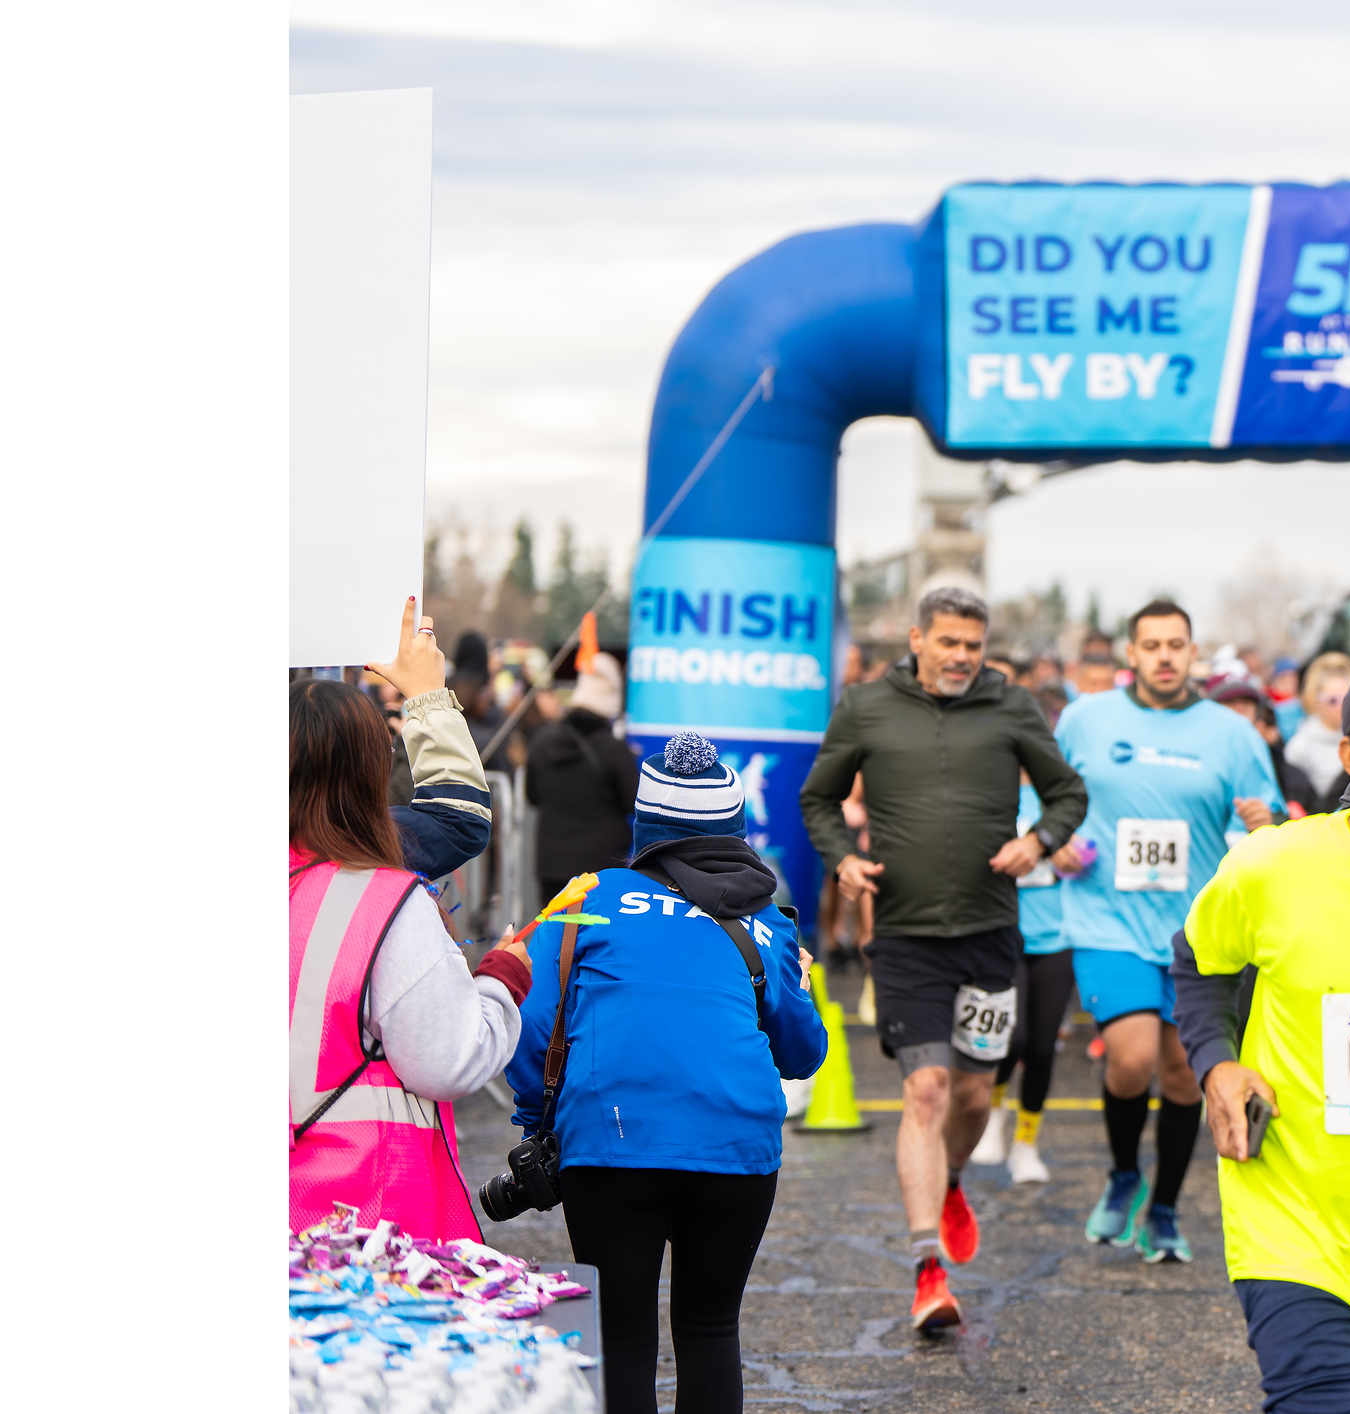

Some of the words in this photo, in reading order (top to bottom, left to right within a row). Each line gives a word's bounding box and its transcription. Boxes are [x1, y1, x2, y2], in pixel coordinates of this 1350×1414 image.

[969, 236, 1073, 273] DID
[1094, 235, 1213, 273] YOU
[972, 296, 1075, 335] SEE
[1098, 297, 1180, 335] ME
[967, 354, 1074, 399] FLY
[1086, 354, 1195, 399] BY?
[637, 587, 817, 642] FINISH
[1129, 840, 1177, 865] 384
